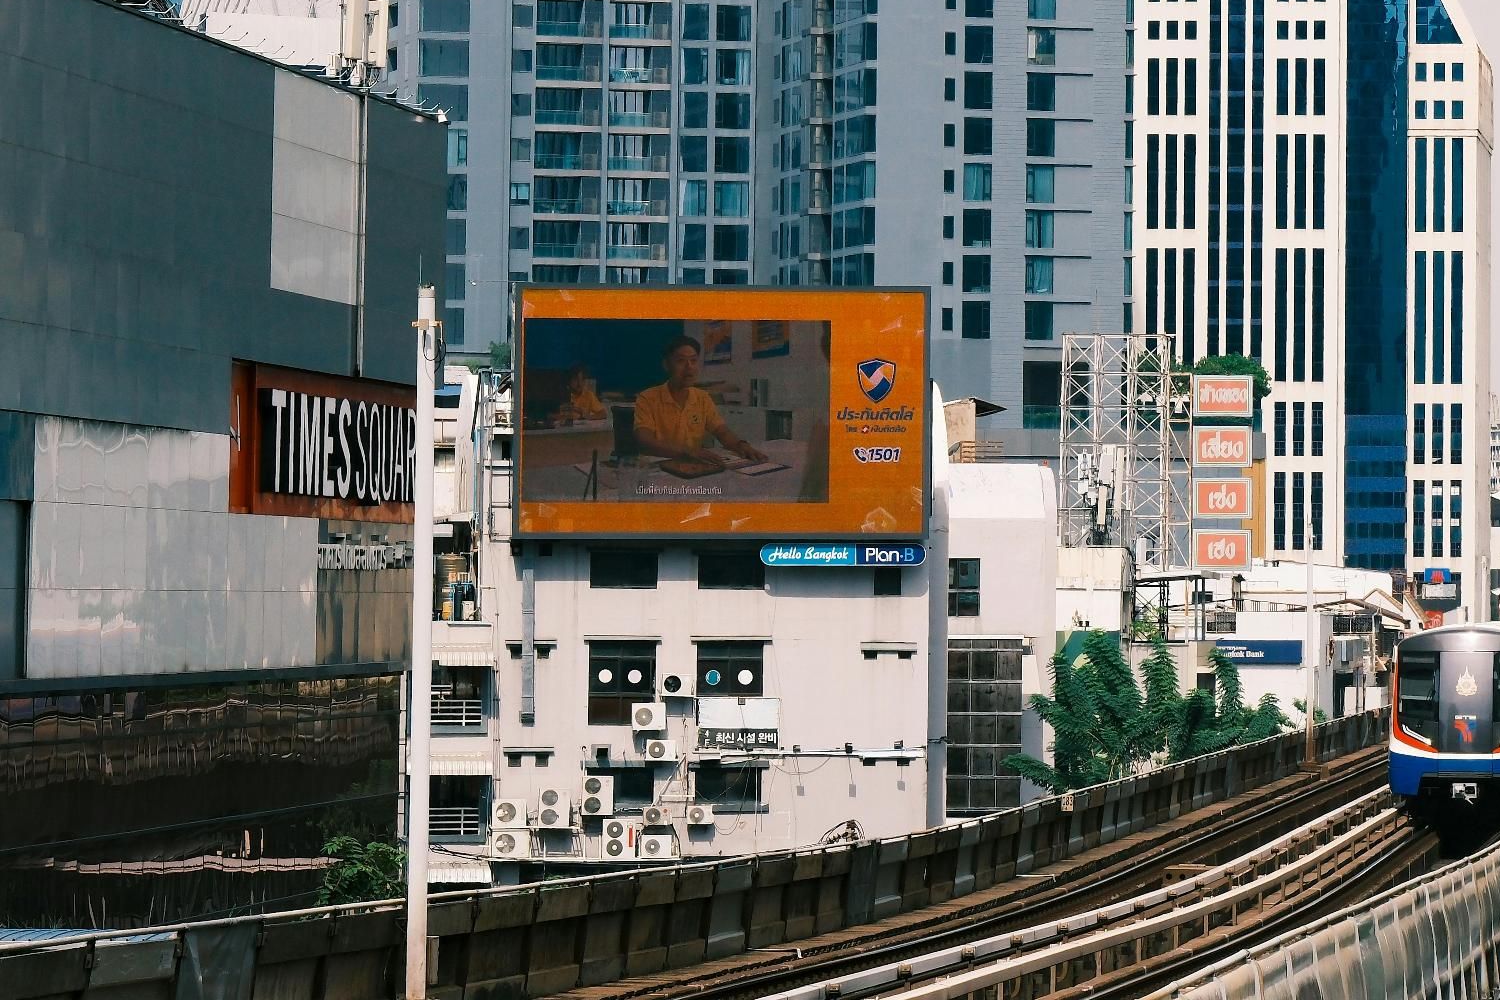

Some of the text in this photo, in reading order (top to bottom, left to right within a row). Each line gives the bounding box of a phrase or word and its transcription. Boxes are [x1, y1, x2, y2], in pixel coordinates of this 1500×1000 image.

[836, 405, 916, 421] ประกันติดโล่
[271, 388, 417, 505] TIMES SQUAR
[867, 447, 901, 462] 1501
[768, 546, 849, 563] Hello Bangkok
[1246, 650, 1265, 658] Bank
[715, 732, 777, 744] 최신 시설 완비
